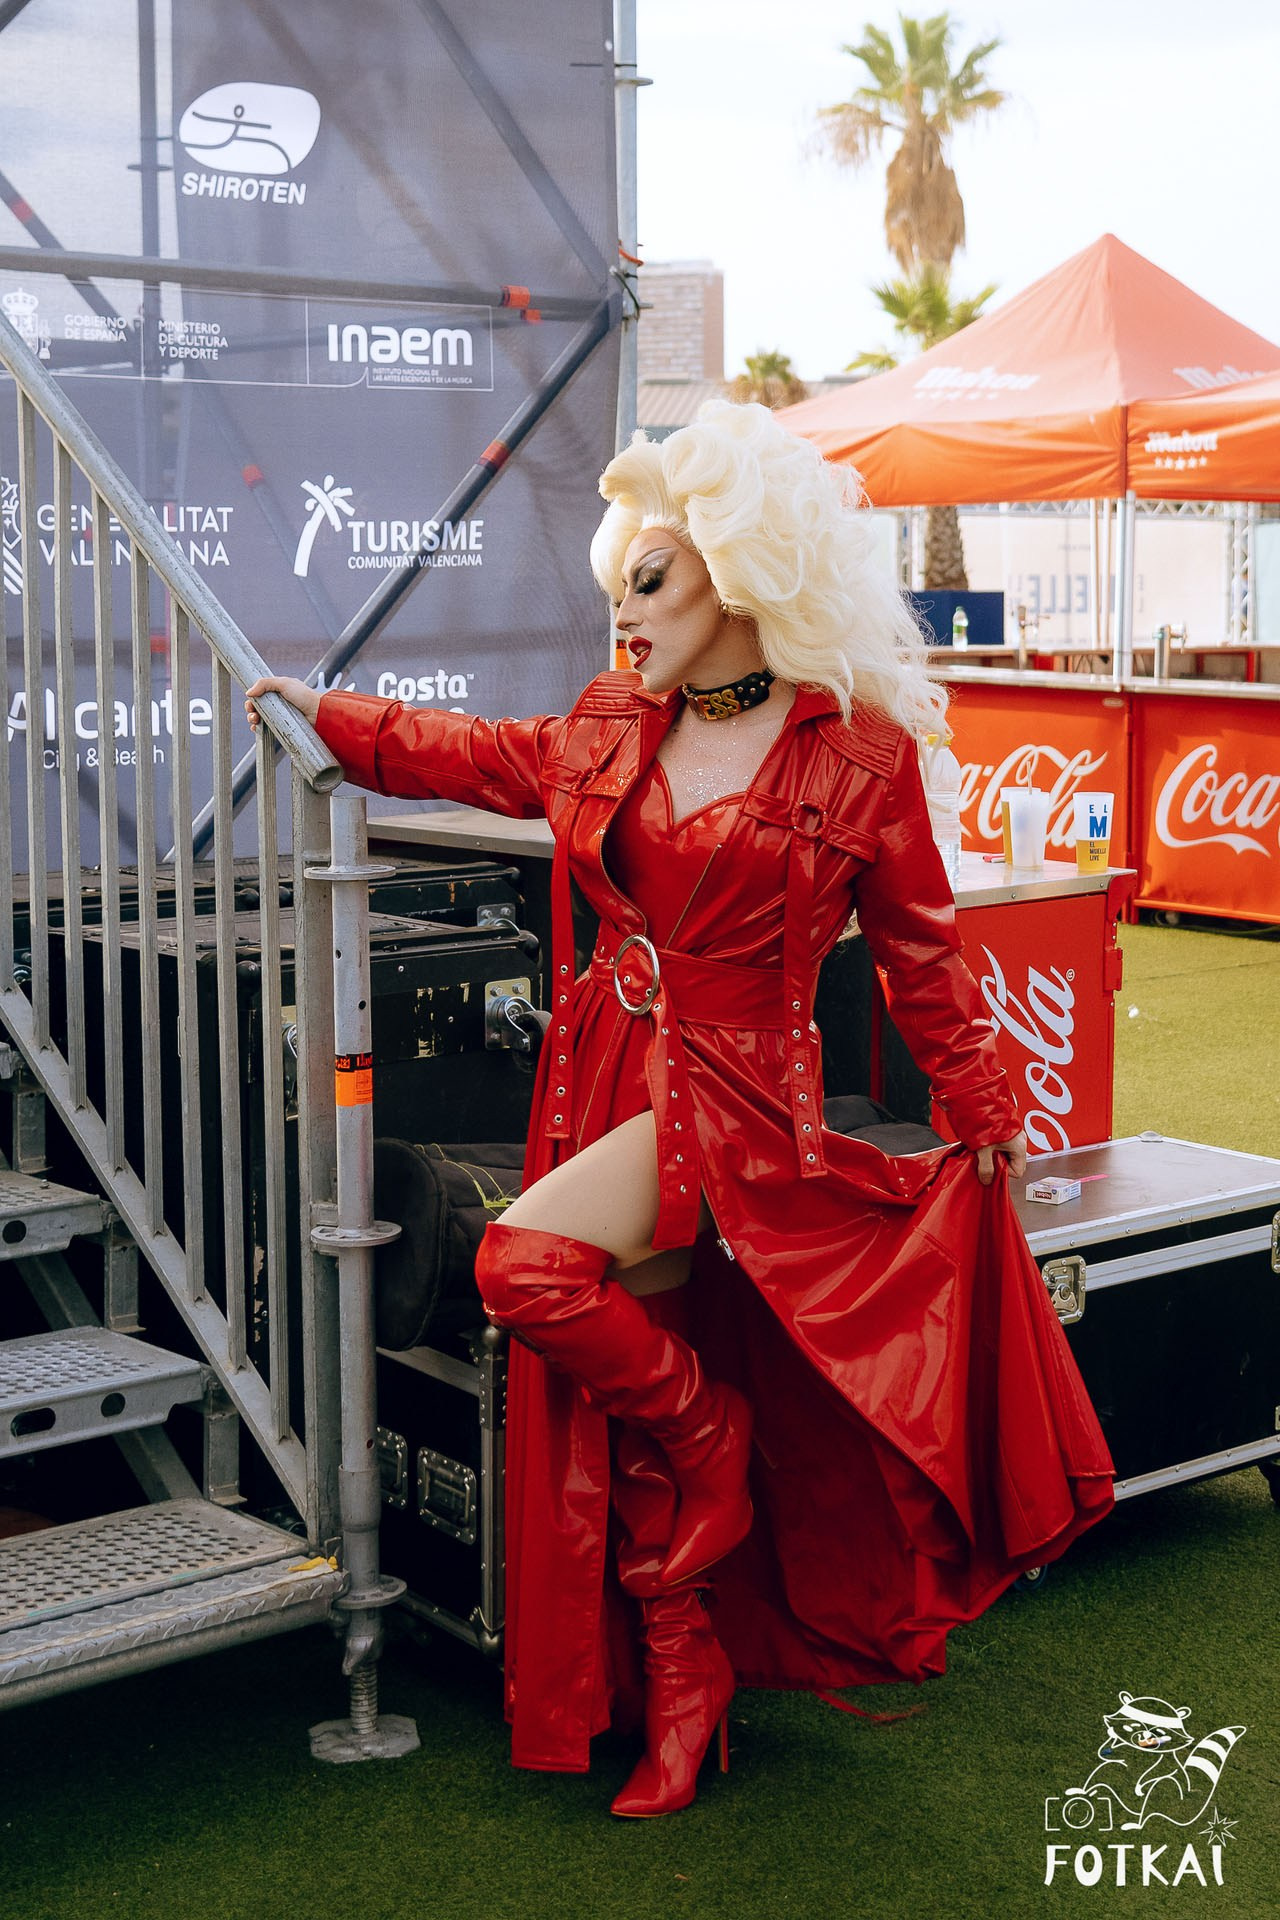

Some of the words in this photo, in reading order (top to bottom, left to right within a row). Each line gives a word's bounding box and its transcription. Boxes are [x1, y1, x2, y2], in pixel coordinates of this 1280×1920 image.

[181, 172, 306, 205] SHIROTEN
[64, 314, 128, 329] GOBIERNO
[158, 320, 221, 335] MINISTERIO
[64, 328, 80, 339] DE
[83, 327, 127, 342] ESPAÑA
[158, 333, 174, 345] DE
[176, 334, 229, 347] CULTURA
[158, 346, 166, 357] Y
[169, 347, 219, 360] DEPORTE
[347, 520, 484, 553] TURISME
[347, 555, 416, 569] COMUNITAT
[418, 554, 483, 568] VALENCIANA
[1089, 815, 1107, 838] M
